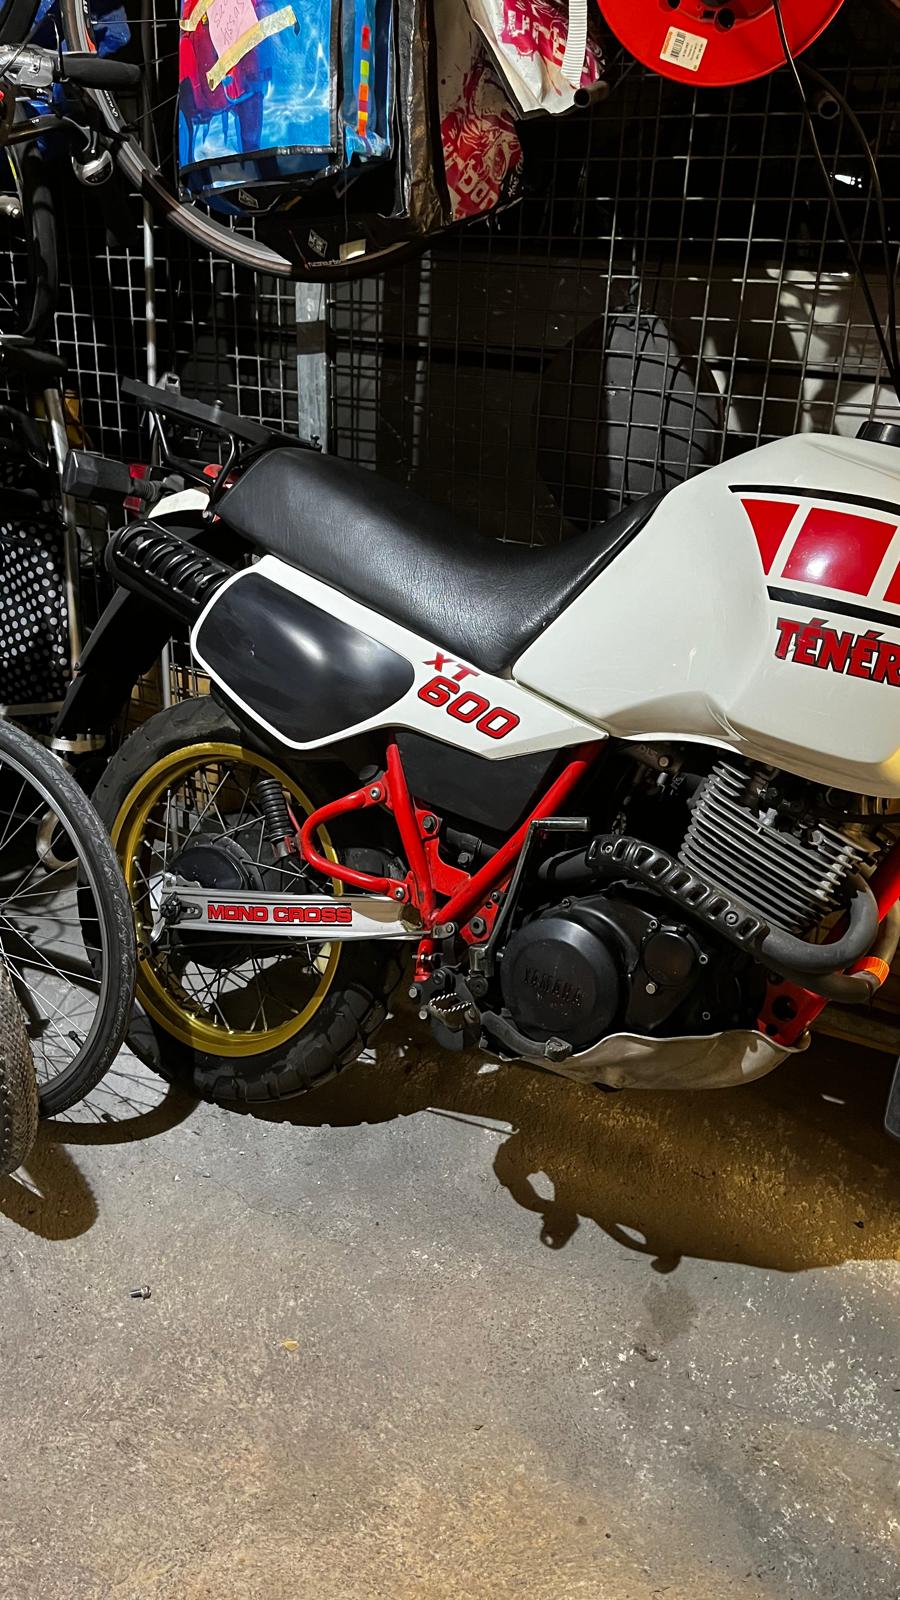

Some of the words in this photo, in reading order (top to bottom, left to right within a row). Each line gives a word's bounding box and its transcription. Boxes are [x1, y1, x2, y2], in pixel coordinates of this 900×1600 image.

[422, 651, 481, 682] XT
[417, 675, 521, 740] 600
[208, 904, 269, 922] MONO
[273, 906, 353, 923] CROSS
[522, 967, 584, 1003] YAMAHA
